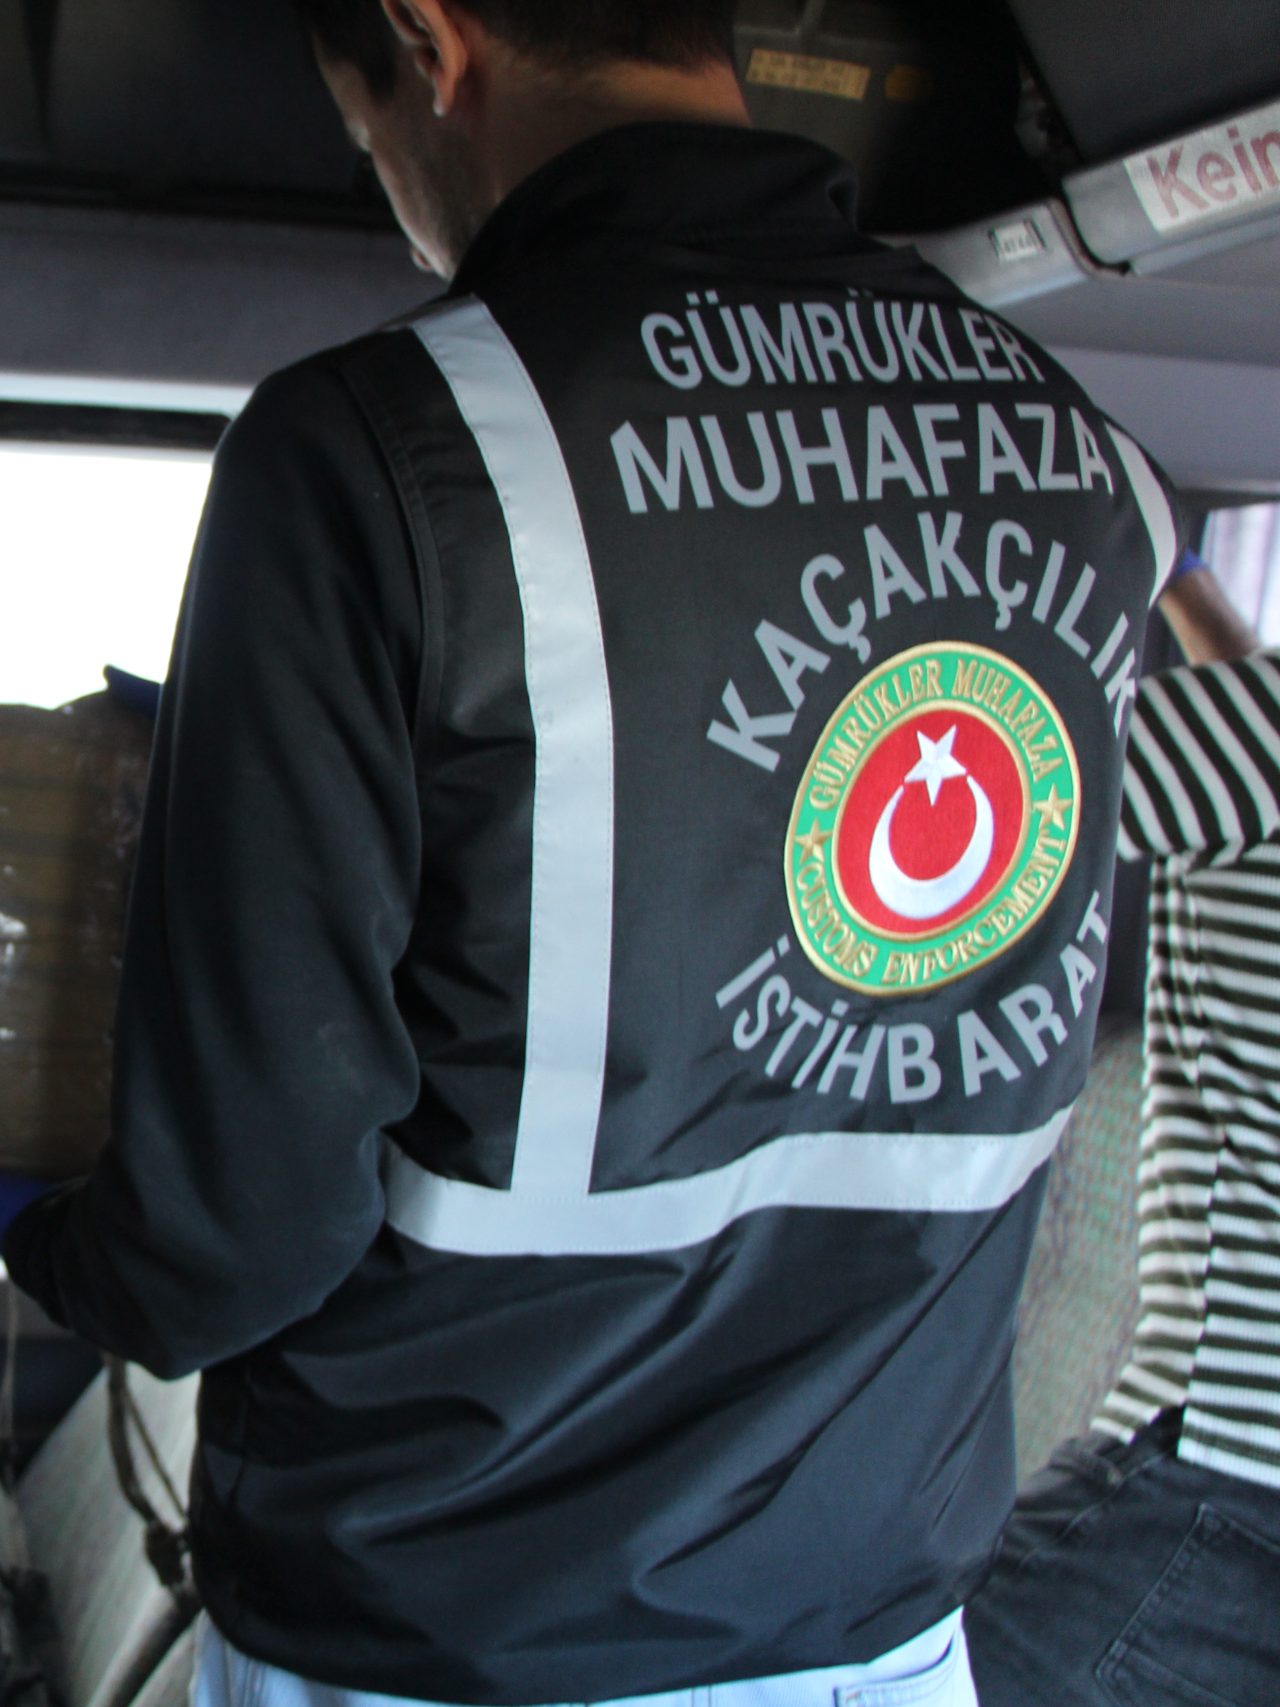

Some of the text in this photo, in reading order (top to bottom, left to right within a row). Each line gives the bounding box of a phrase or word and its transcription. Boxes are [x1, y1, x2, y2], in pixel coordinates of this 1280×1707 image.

[641, 287, 1045, 390] GÜMRÜKLER
[610, 402, 1114, 514] MUHAFAZA
[707, 511, 1136, 772] KAÇAKÇILIK
[809, 659, 1063, 811] GÜMRÜKLER MUHAFAZA
[796, 827, 1067, 985] CUSTOMS ENFORCEMENT
[716, 889, 1108, 1105] İSTİHBARAT
